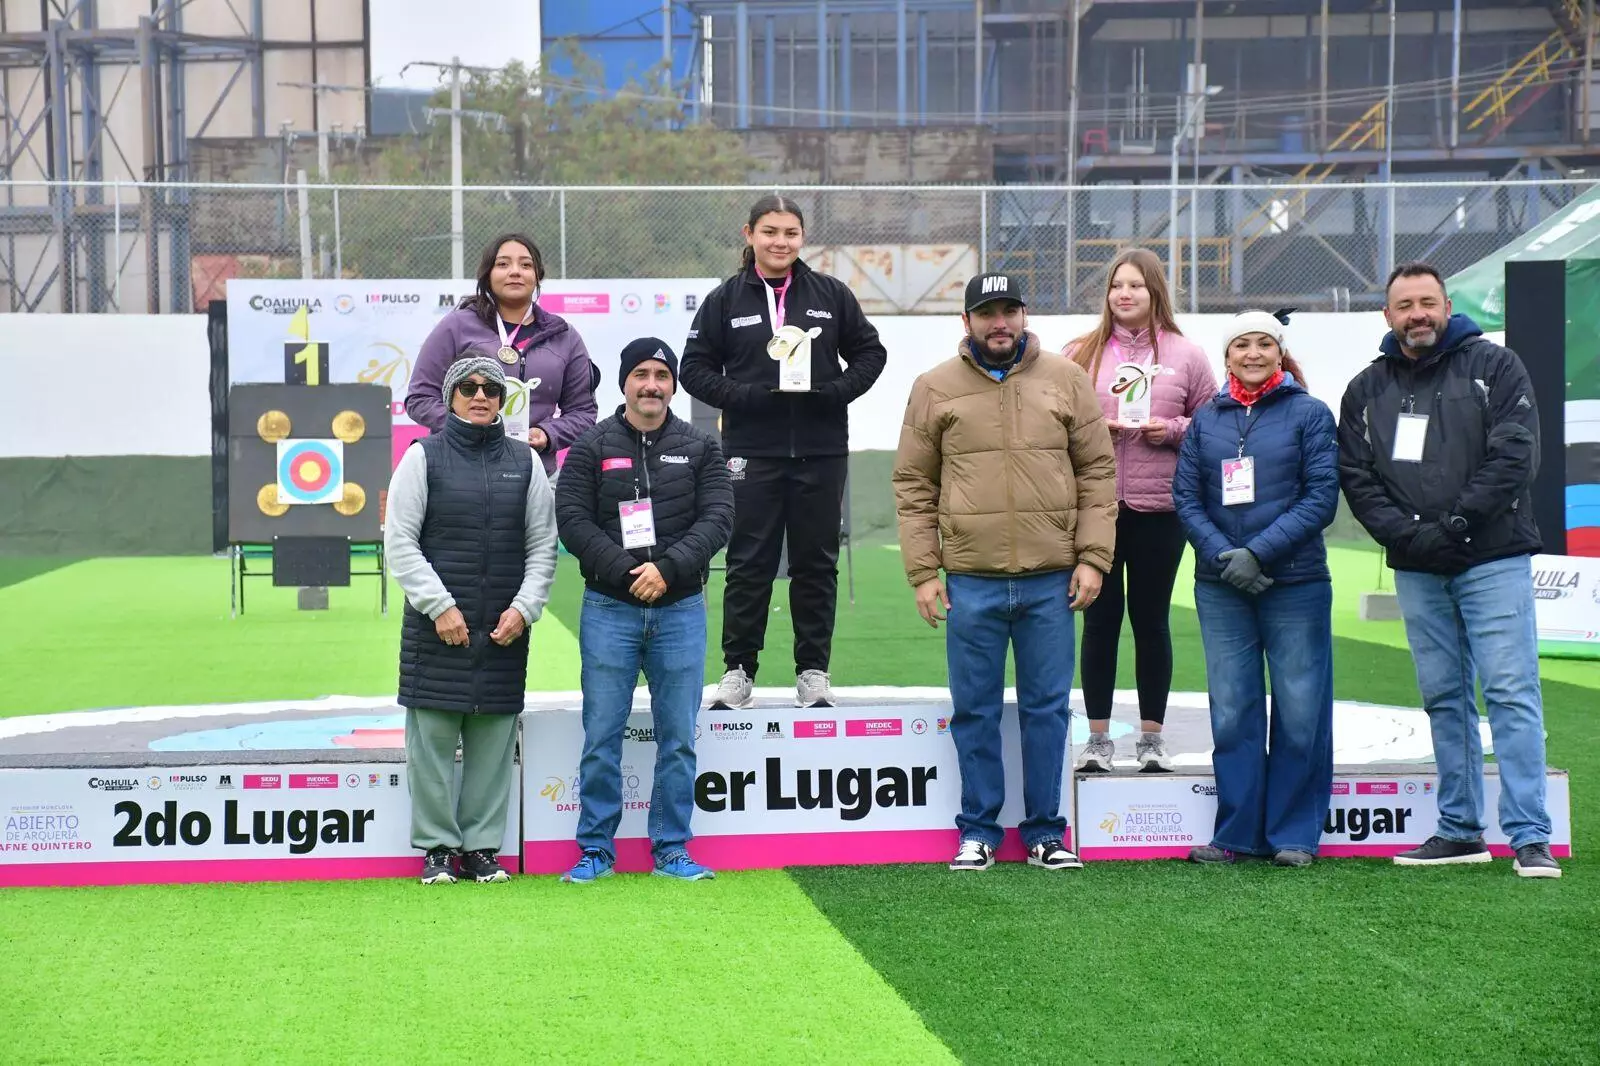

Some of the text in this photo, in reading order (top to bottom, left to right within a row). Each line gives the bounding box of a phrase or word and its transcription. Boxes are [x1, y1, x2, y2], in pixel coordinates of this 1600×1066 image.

[981, 276, 1008, 294] MVA
[249, 295, 322, 310] COAHUILA
[366, 294, 420, 304] IMPULSO
[295, 343, 319, 385] 1
[1533, 570, 1580, 588] UILA
[624, 726, 654, 739] COAH
[710, 722, 753, 731] IMPULSO
[767, 722, 780, 732] M
[88, 777, 139, 788] COAHUILA
[169, 775, 208, 783] IMPULSO
[219, 775, 231, 785] M
[694, 757, 938, 821] er Lugar
[1191, 784, 1216, 793] COAH
[5, 815, 80, 830] ABIERTO
[1124, 812, 1183, 825] ABIERTO
[1323, 807, 1412, 841] ugar
[113, 799, 375, 855] 2do Lugar
[1125, 826, 1137, 834] DE
[6, 829, 79, 842] DE ARQUERÍA
[1113, 834, 1194, 843] DAFNE QUINTERO
[0, 841, 93, 852] AFNE QUINTERO
